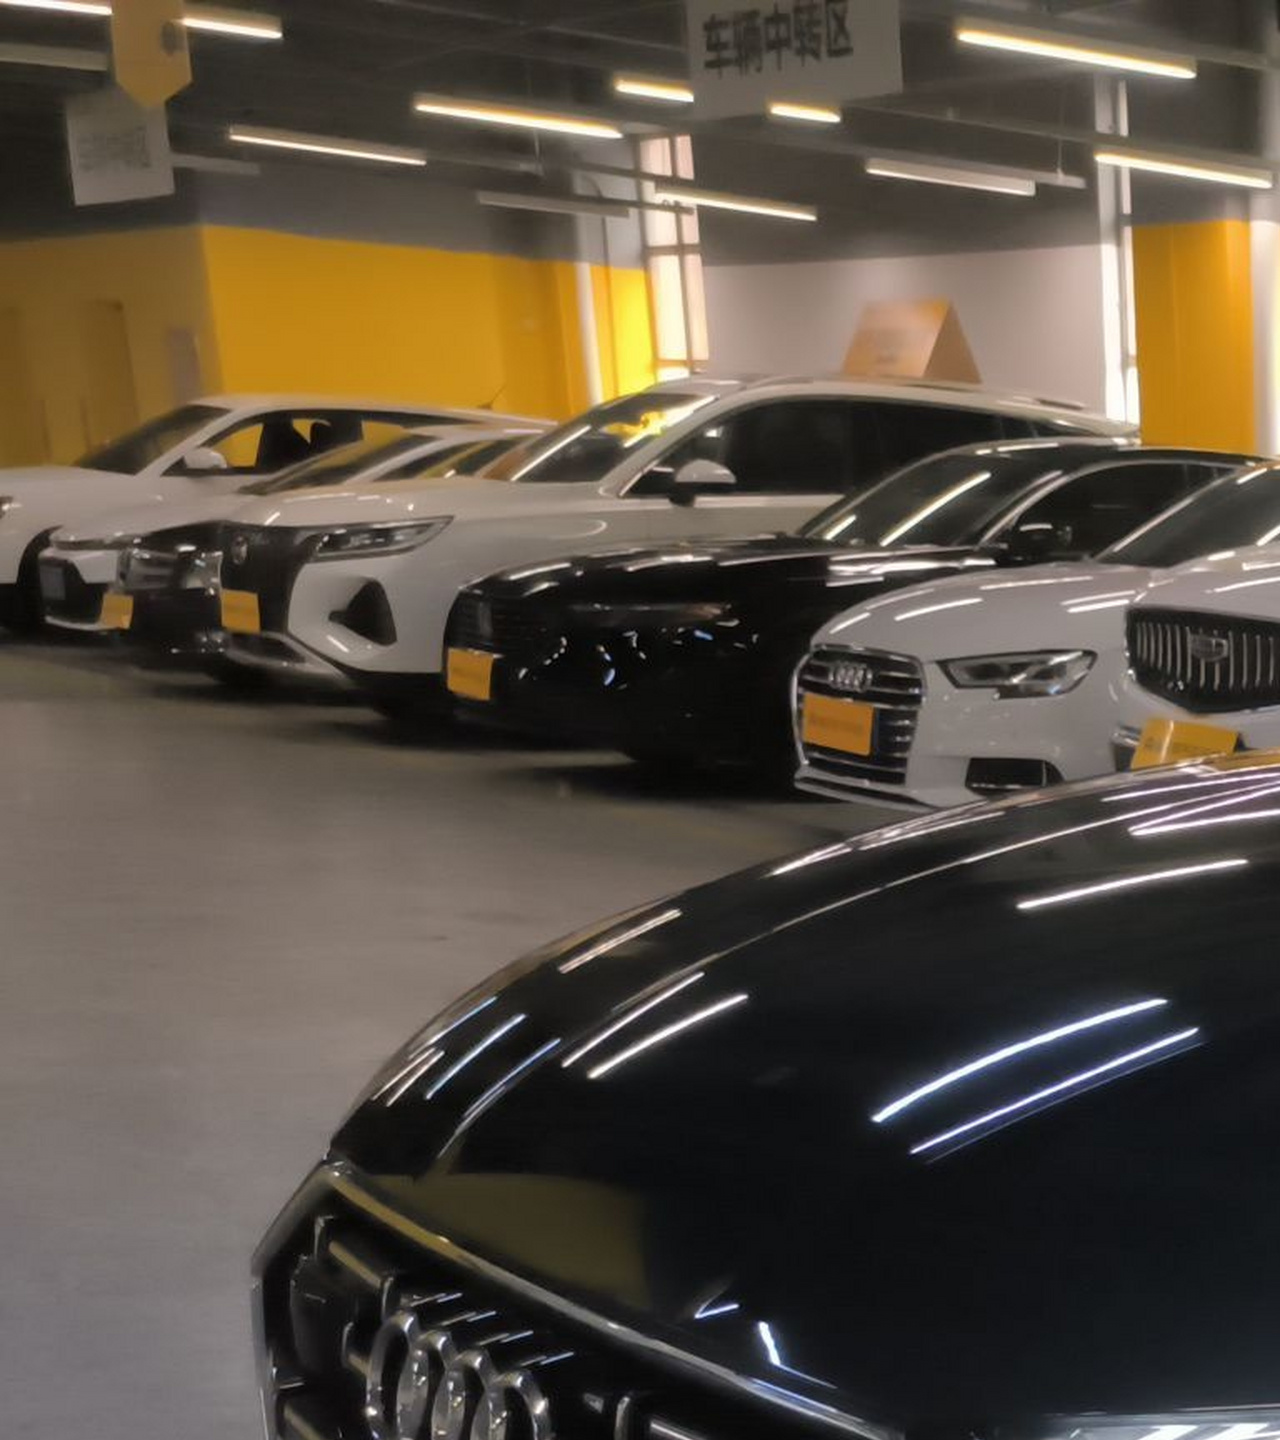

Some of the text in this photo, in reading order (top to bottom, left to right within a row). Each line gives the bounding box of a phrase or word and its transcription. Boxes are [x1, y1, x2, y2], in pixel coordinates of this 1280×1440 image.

[703, 0, 853, 79] 车辆中转区
